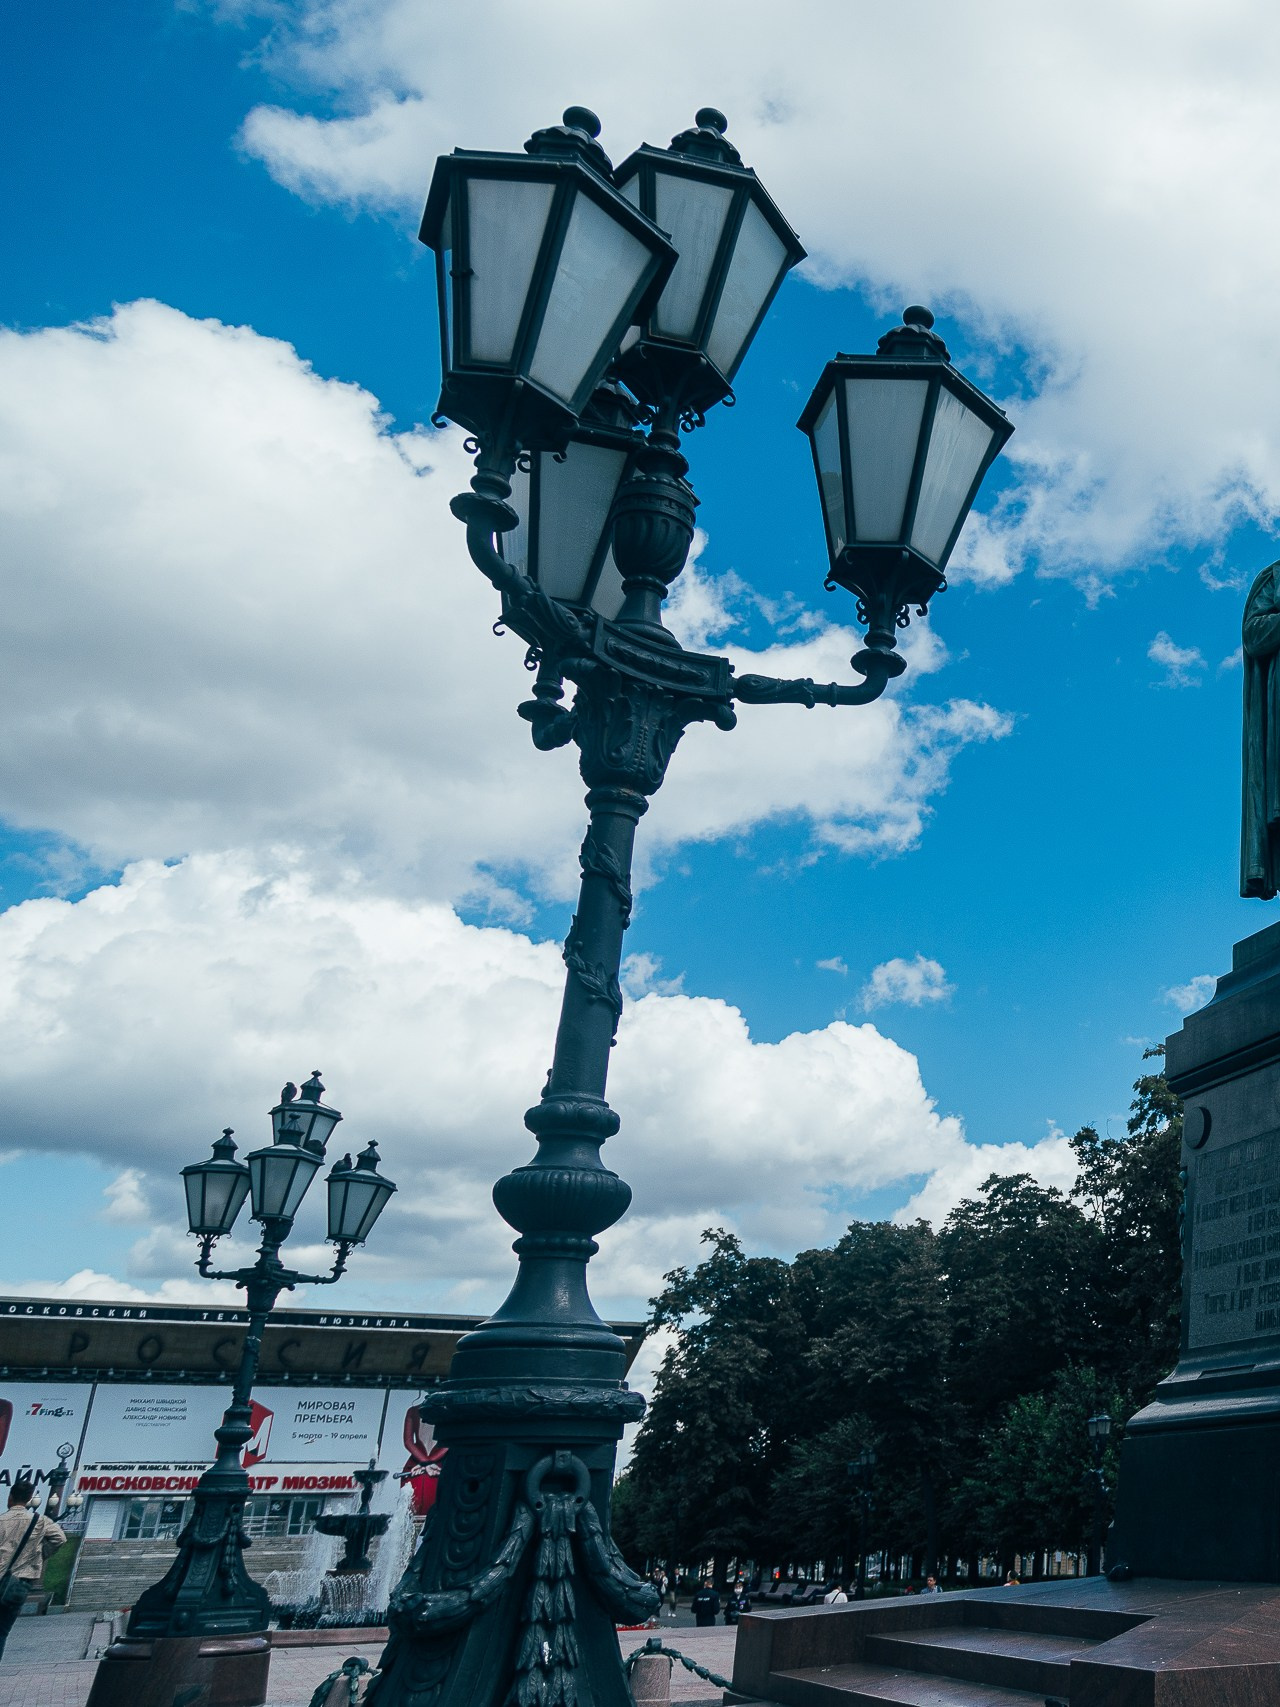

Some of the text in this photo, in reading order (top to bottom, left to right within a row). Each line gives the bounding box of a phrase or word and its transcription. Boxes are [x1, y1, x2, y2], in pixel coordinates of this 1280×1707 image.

[202, 1312, 268, 1321] ТЕА
[319, 1316, 410, 1327] МЮЗИКЛА
[67, 1330, 431, 1371] РОССИЯ
[297, 1401, 355, 1411] МИРОВАЯ
[294, 1414, 353, 1424] ПРЕМЬЕРА
[339, 1433, 368, 1441] апреля
[78, 1476, 200, 1491] МОСКОВСКИ
[282, 1475, 363, 1490] МЮЗИК
